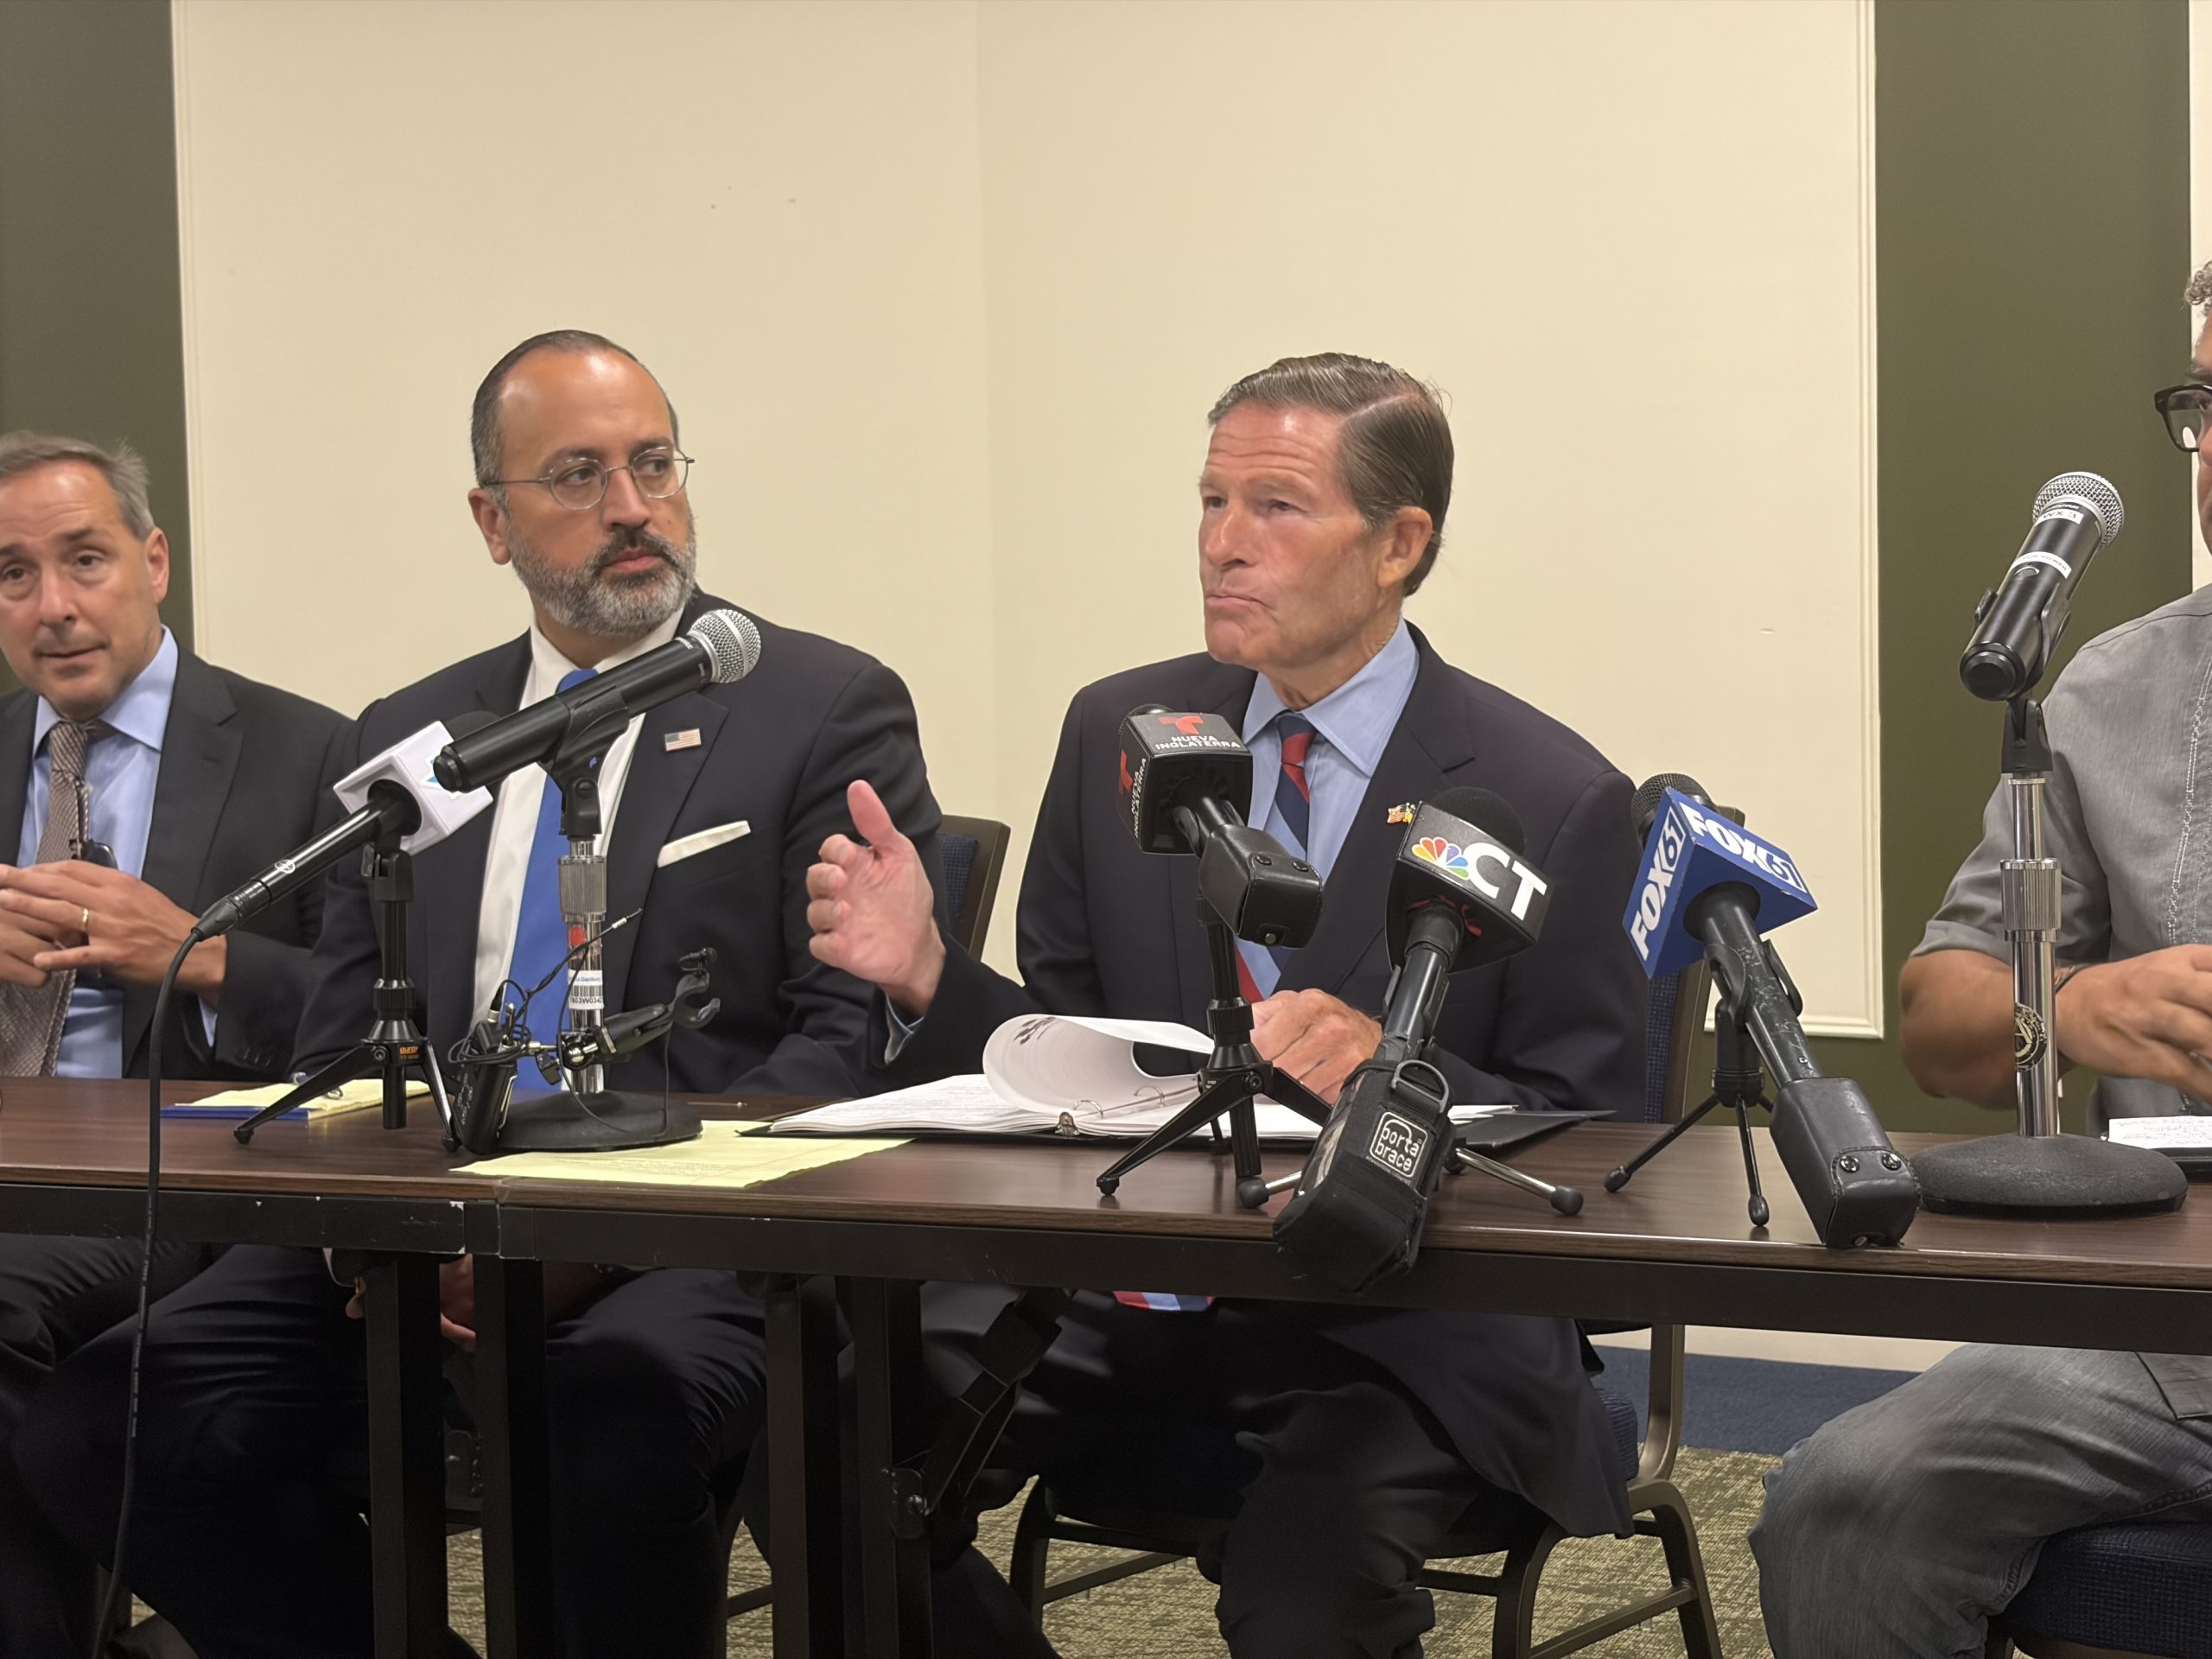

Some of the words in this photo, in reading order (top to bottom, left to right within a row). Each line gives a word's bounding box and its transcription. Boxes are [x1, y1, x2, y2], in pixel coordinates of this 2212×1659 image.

[2043, 511, 2064, 519] WX
[1154, 741, 1242, 750] INGLATERRA
[1130, 771, 1140, 815] NUEVA
[1134, 758, 1147, 839] INGLATERRA
[1463, 842, 1548, 921] CT
[1374, 1142, 1413, 1172] brace
[1378, 1123, 1421, 1158] porta
